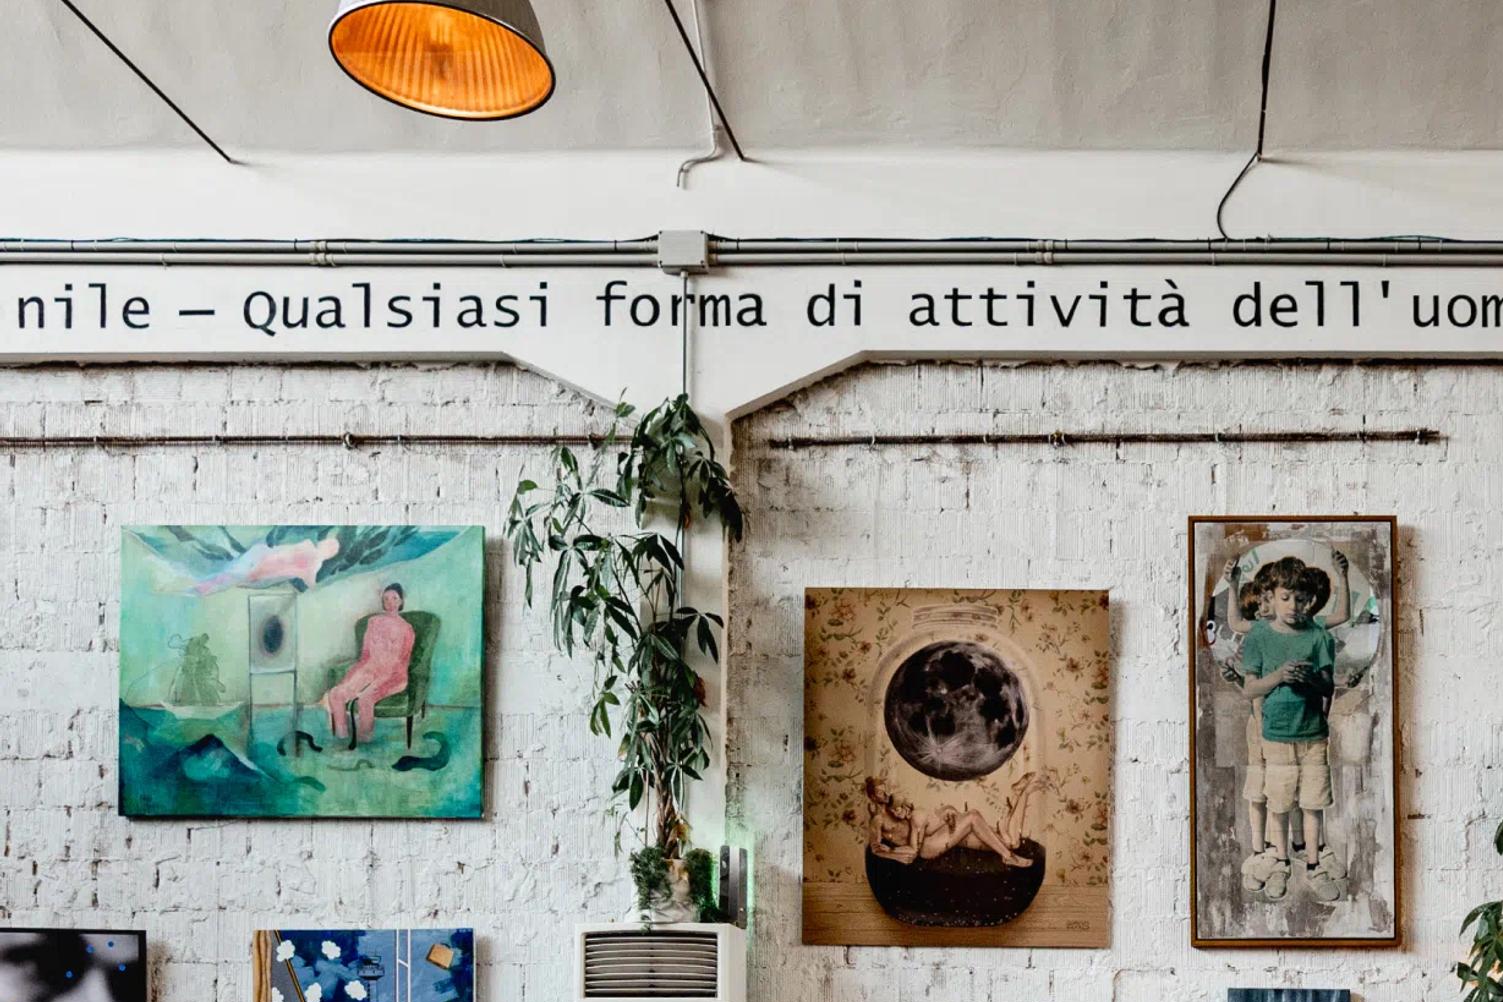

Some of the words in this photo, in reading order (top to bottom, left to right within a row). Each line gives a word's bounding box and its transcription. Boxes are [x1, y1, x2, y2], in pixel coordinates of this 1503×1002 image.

[18, 282, 150, 329] nile
[243, 281, 548, 337] Qualsiasi
[596, 280, 767, 328] forma
[807, 279, 863, 328] di
[909, 279, 1190, 328] attività
